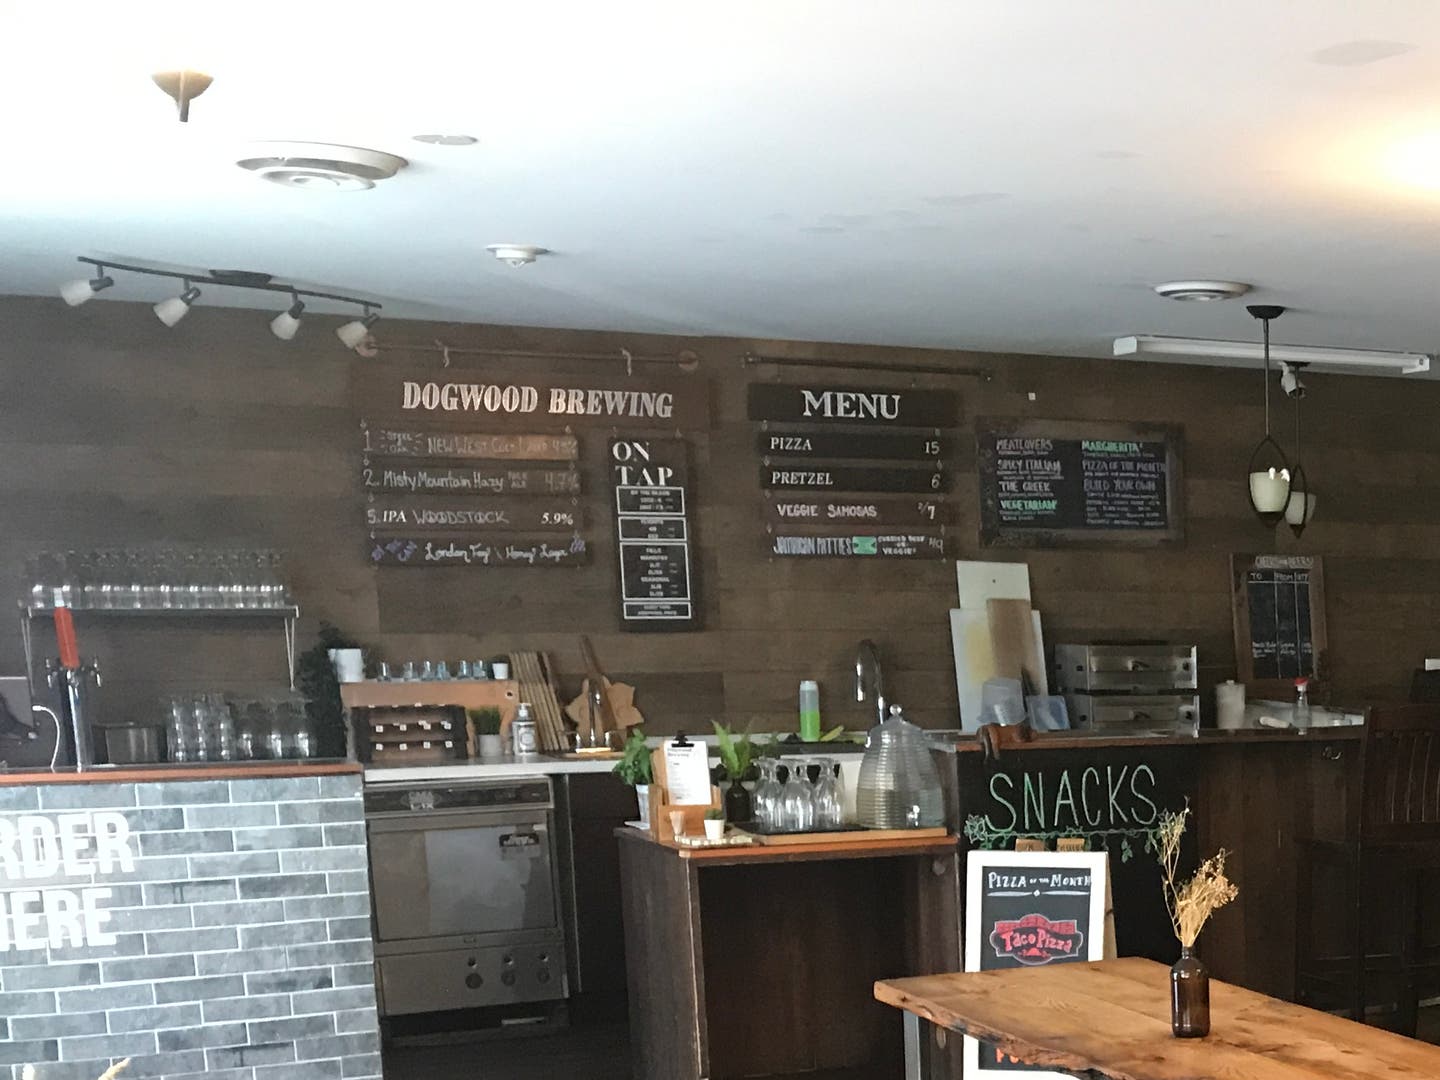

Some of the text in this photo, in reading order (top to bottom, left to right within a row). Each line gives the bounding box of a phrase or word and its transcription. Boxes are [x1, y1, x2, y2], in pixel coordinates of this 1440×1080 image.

[402, 381, 673, 418] DOGWOOD BREWING
[801, 390, 900, 420] MENU
[612, 441, 650, 462] ON
[770, 436, 812, 451] PIZZA
[924, 441, 940, 454] 15
[1082, 460, 1108, 470] PIZZA
[383, 470, 417, 491] Misty
[417, 471, 471, 489] Mountain
[473, 471, 504, 492] Hazy
[614, 466, 674, 486] TAP
[771, 471, 833, 486] PRETZEL
[931, 475, 940, 489] 6
[998, 481, 1018, 492] THE
[382, 510, 407, 523] IPA
[411, 509, 510, 525] WOODSTOCK
[540, 511, 574, 527] 5.9%
[777, 503, 878, 518] VEGGIE SAMOSAS
[984, 764, 1157, 832] SNACKS
[988, 871, 1027, 889] PIZZA
[1051, 872, 1092, 888] MONTH
